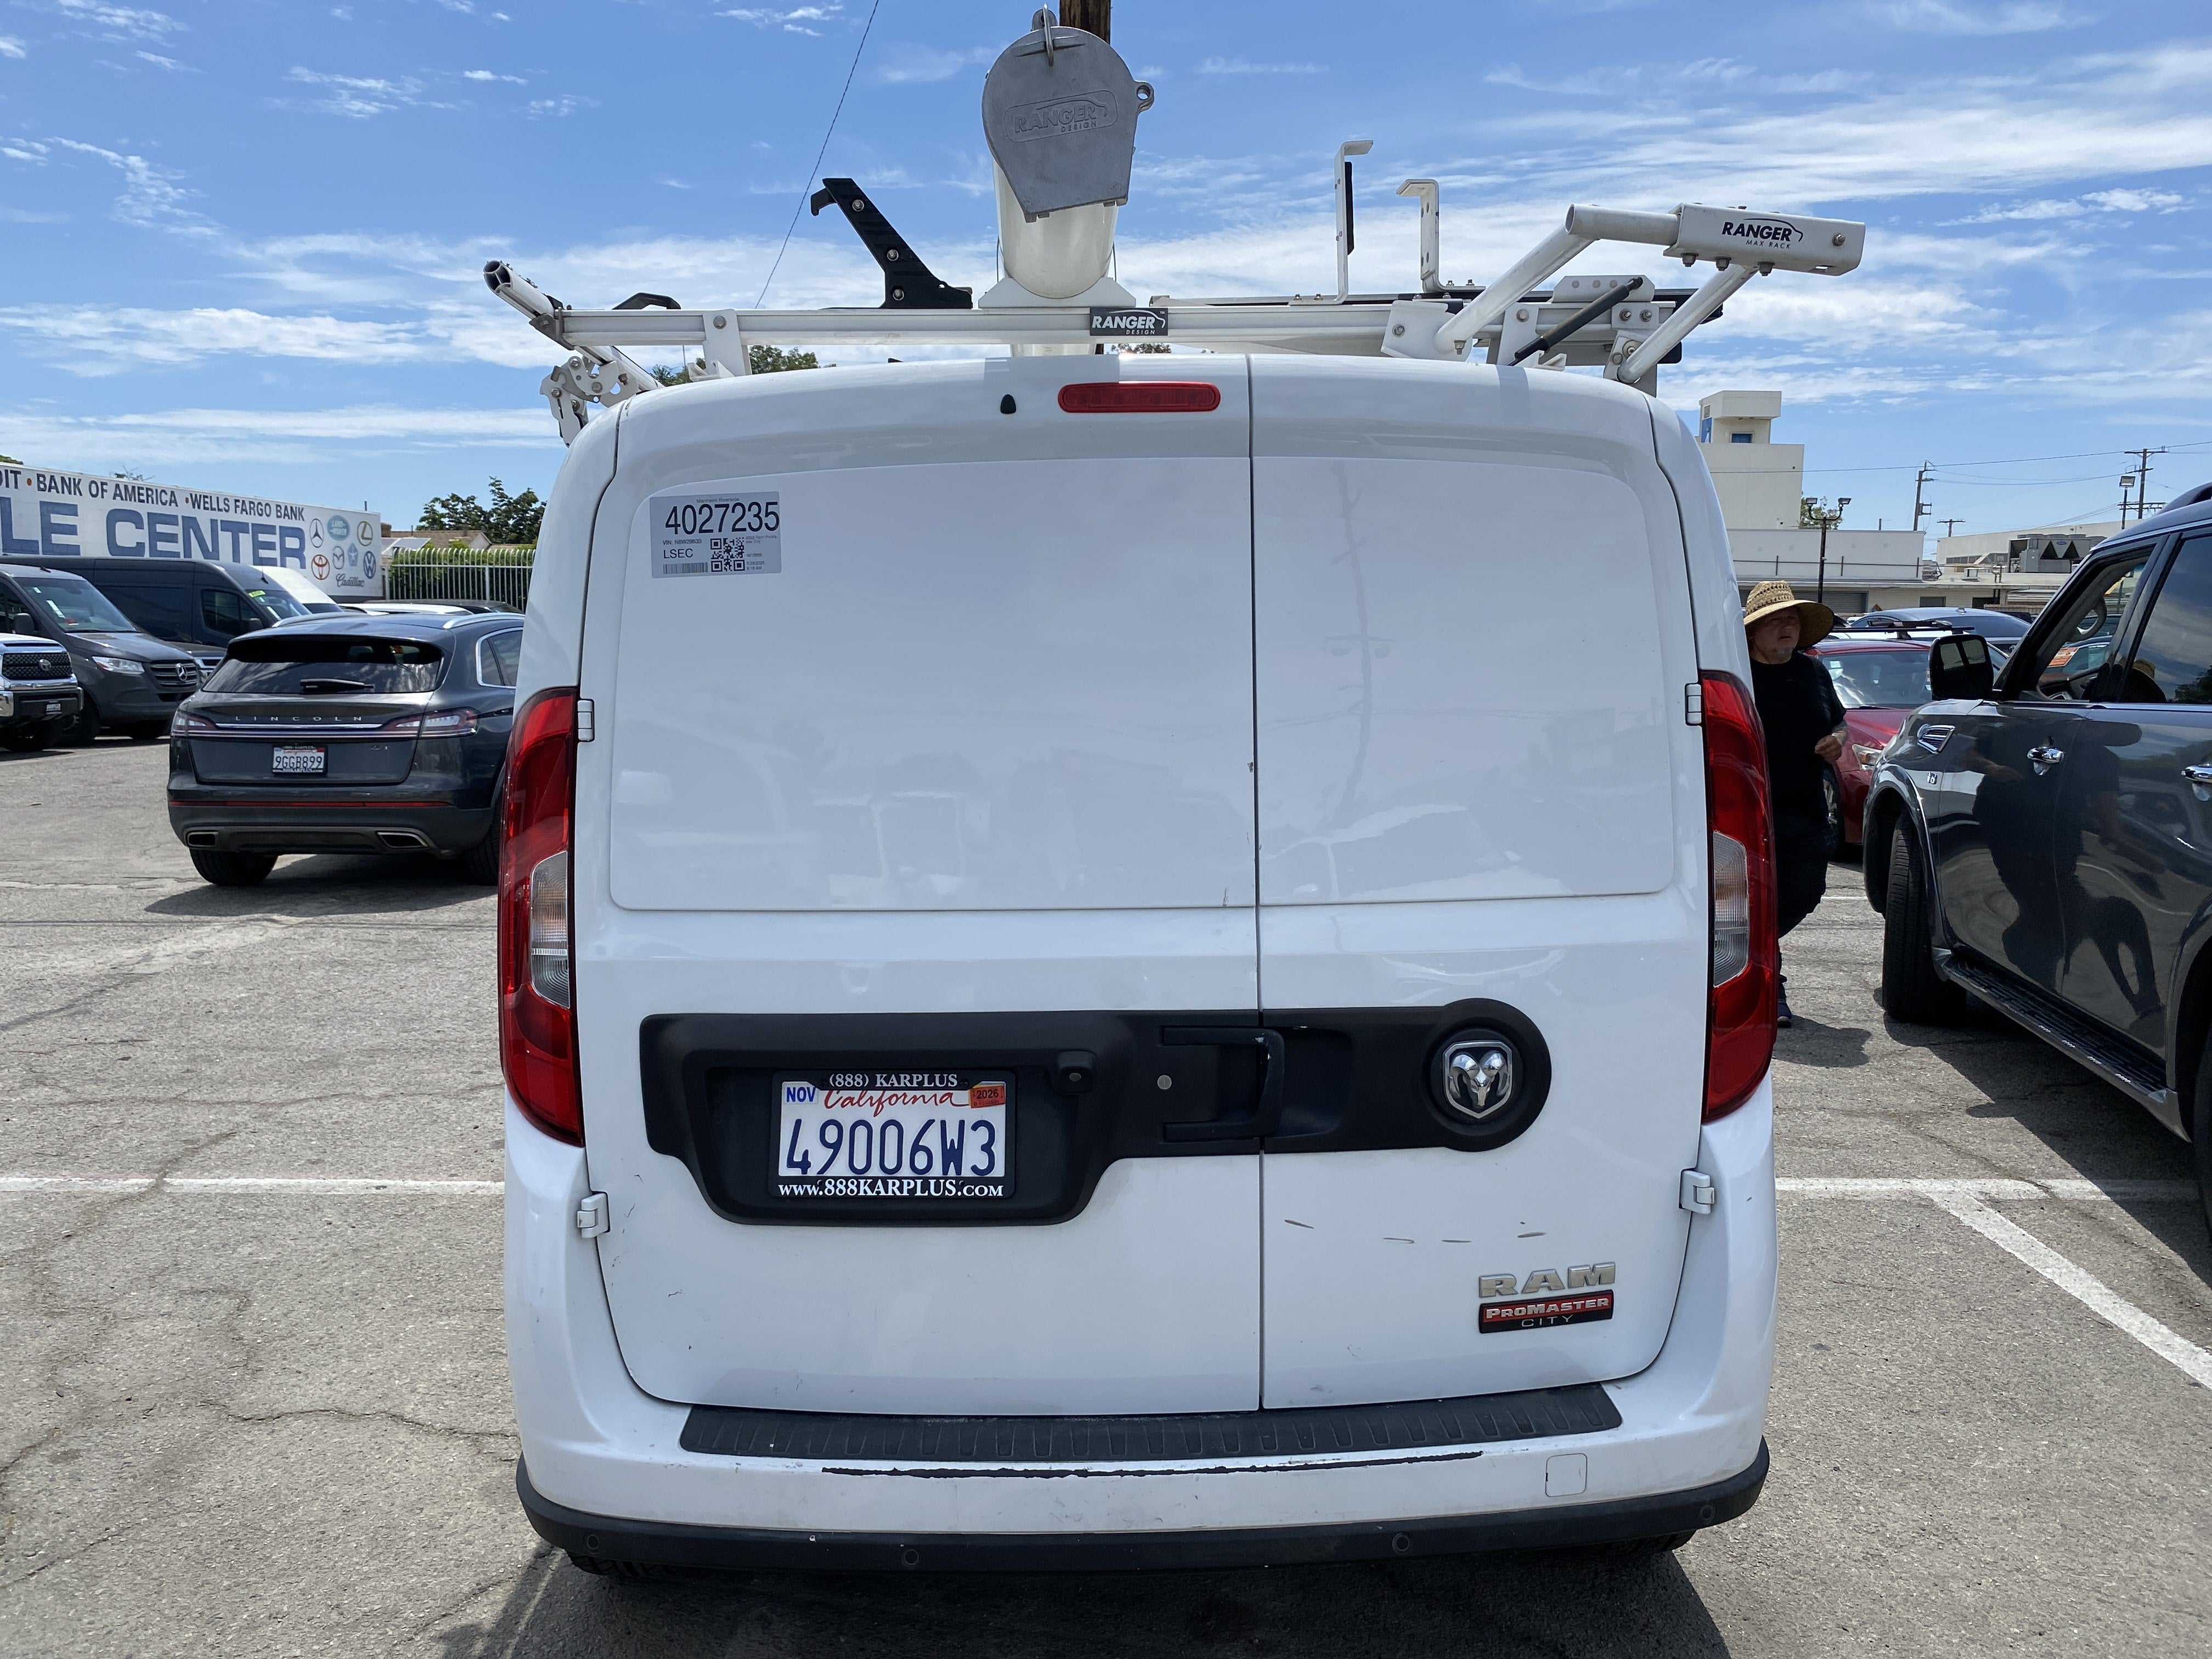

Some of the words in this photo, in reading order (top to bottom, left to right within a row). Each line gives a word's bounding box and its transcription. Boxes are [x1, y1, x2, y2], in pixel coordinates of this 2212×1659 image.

[1015, 105, 1096, 133] RANGER
[1062, 121, 1096, 132] DESIGN
[1722, 222, 1792, 242] RANGER
[1092, 316, 1155, 329] RANGER
[37, 473, 82, 496] BANK
[89, 480, 108, 498] OF
[112, 483, 178, 507] AMERICA
[190, 493, 230, 512] WELLS
[234, 499, 271, 517] FARGO
[276, 504, 304, 521] BANK
[665, 501, 780, 535] 4027235
[106, 508, 306, 569] CENTER
[663, 548, 693, 558] LSEC
[336, 573, 365, 587] Cadillac
[275, 756, 323, 769] 9GGB899
[830, 1074, 869, 1087] (888)
[875, 1074, 957, 1087] KARPLUS
[786, 1086, 816, 1103] NOV
[977, 1088, 998, 1099] 2026
[824, 1090, 969, 1117] California
[787, 1119, 995, 1176] 49006W3
[1479, 1262, 1616, 1298] RAM
[1521, 1314, 1573, 1327] CITY
